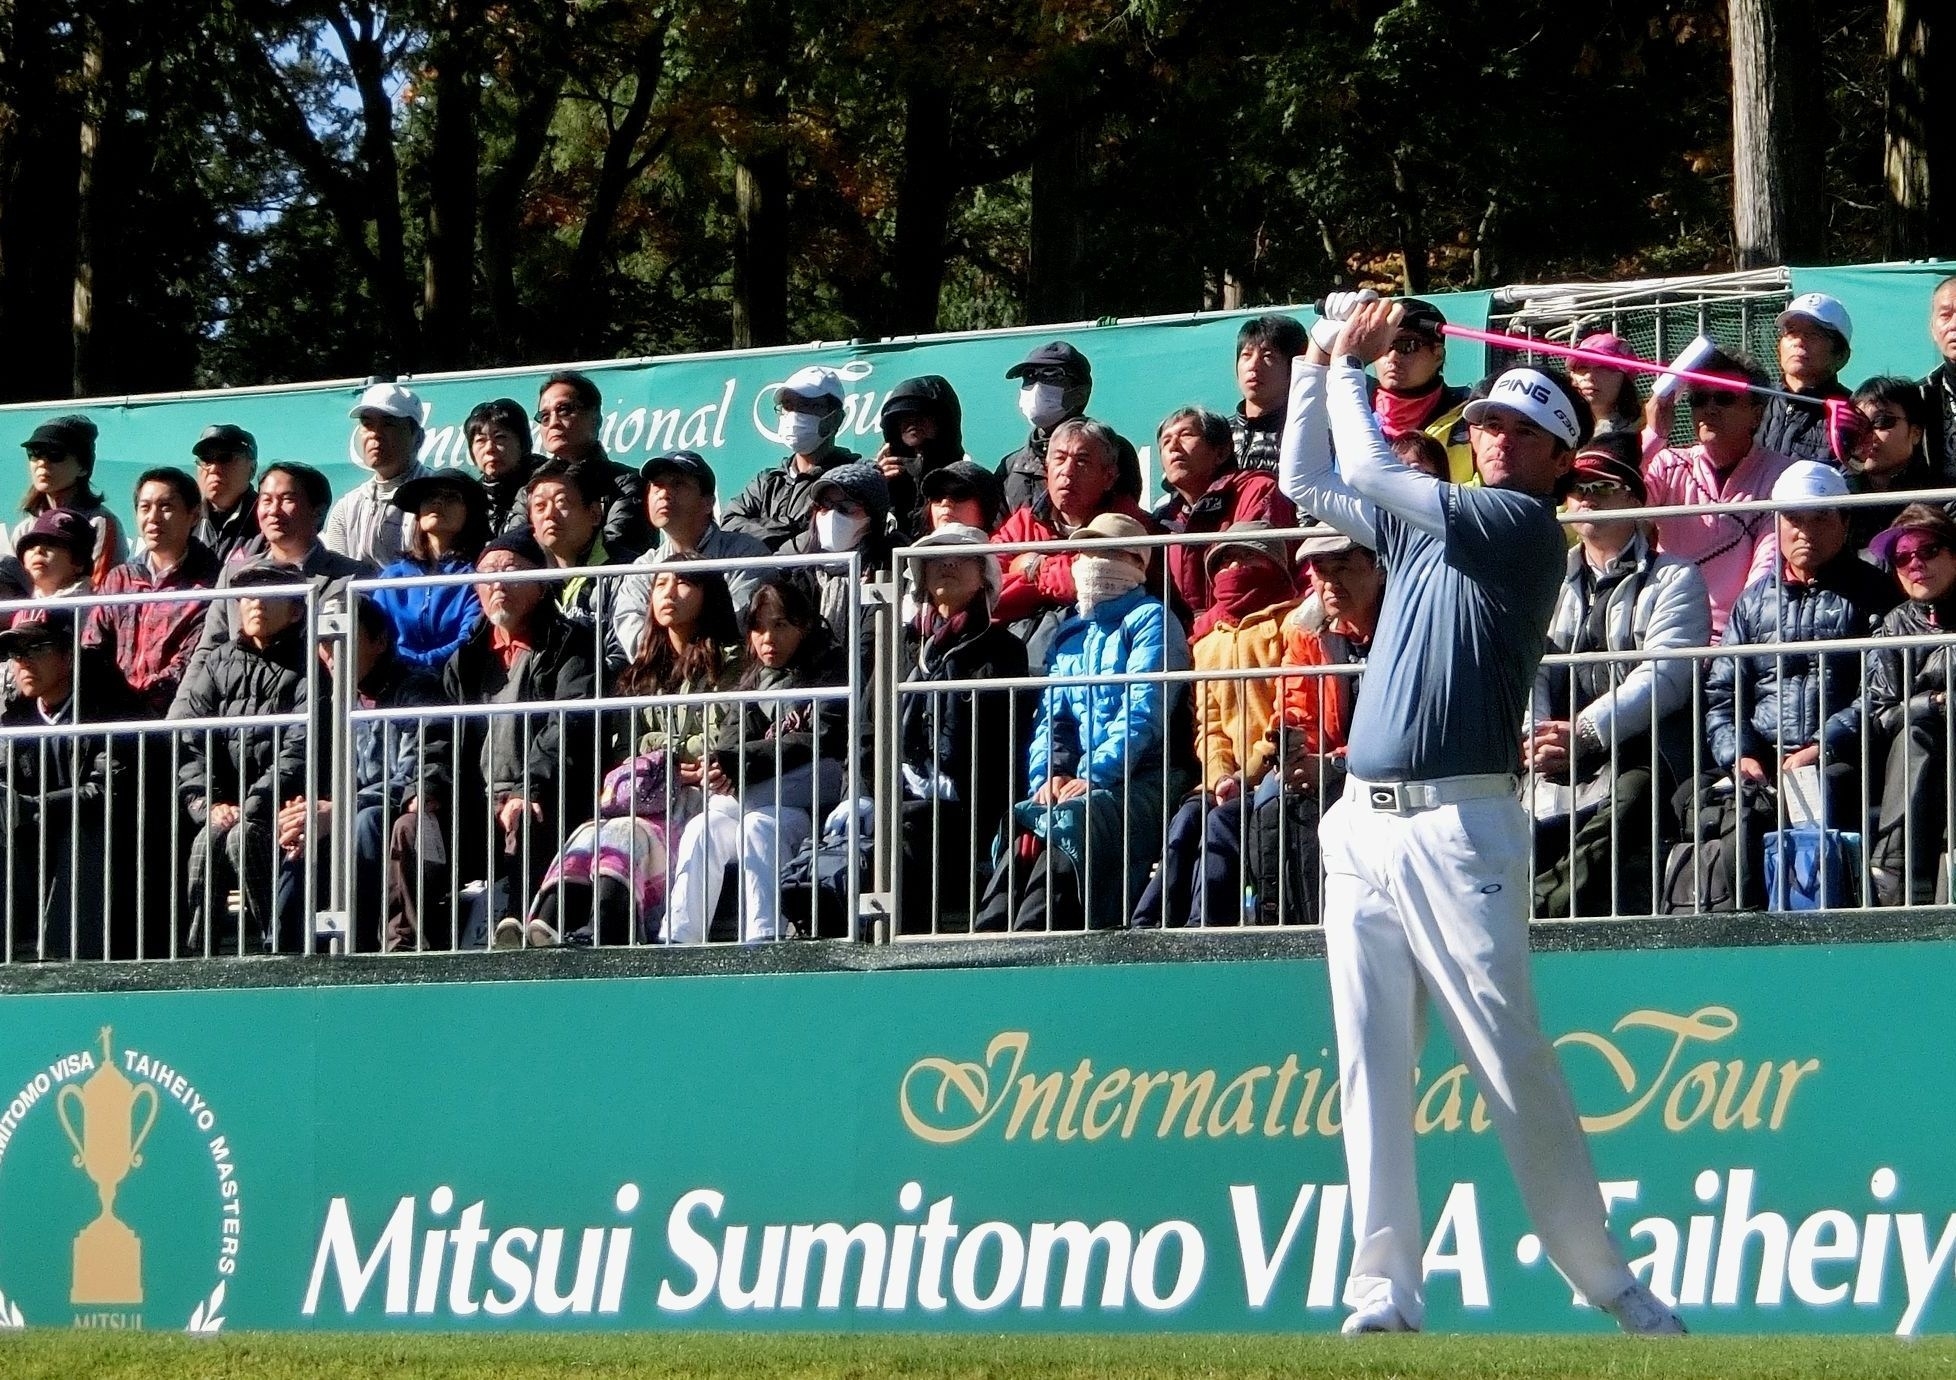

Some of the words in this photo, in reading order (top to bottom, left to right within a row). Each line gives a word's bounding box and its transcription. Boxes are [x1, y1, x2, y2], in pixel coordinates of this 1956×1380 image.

[350, 378, 737, 471] ntional
[1497, 379, 1552, 405] PING
[1554, 408, 1577, 437] G30
[49, 1050, 95, 1082] VISA
[1553, 1005, 1820, 1133] Tour
[124, 1049, 215, 1131] TAIHEIYO
[209, 1134, 241, 1275] MASTERS
[303, 1183, 640, 1315] Mitsui
[657, 1180, 1206, 1311] Sumitomo
[1229, 1182, 1490, 1308] VIA
